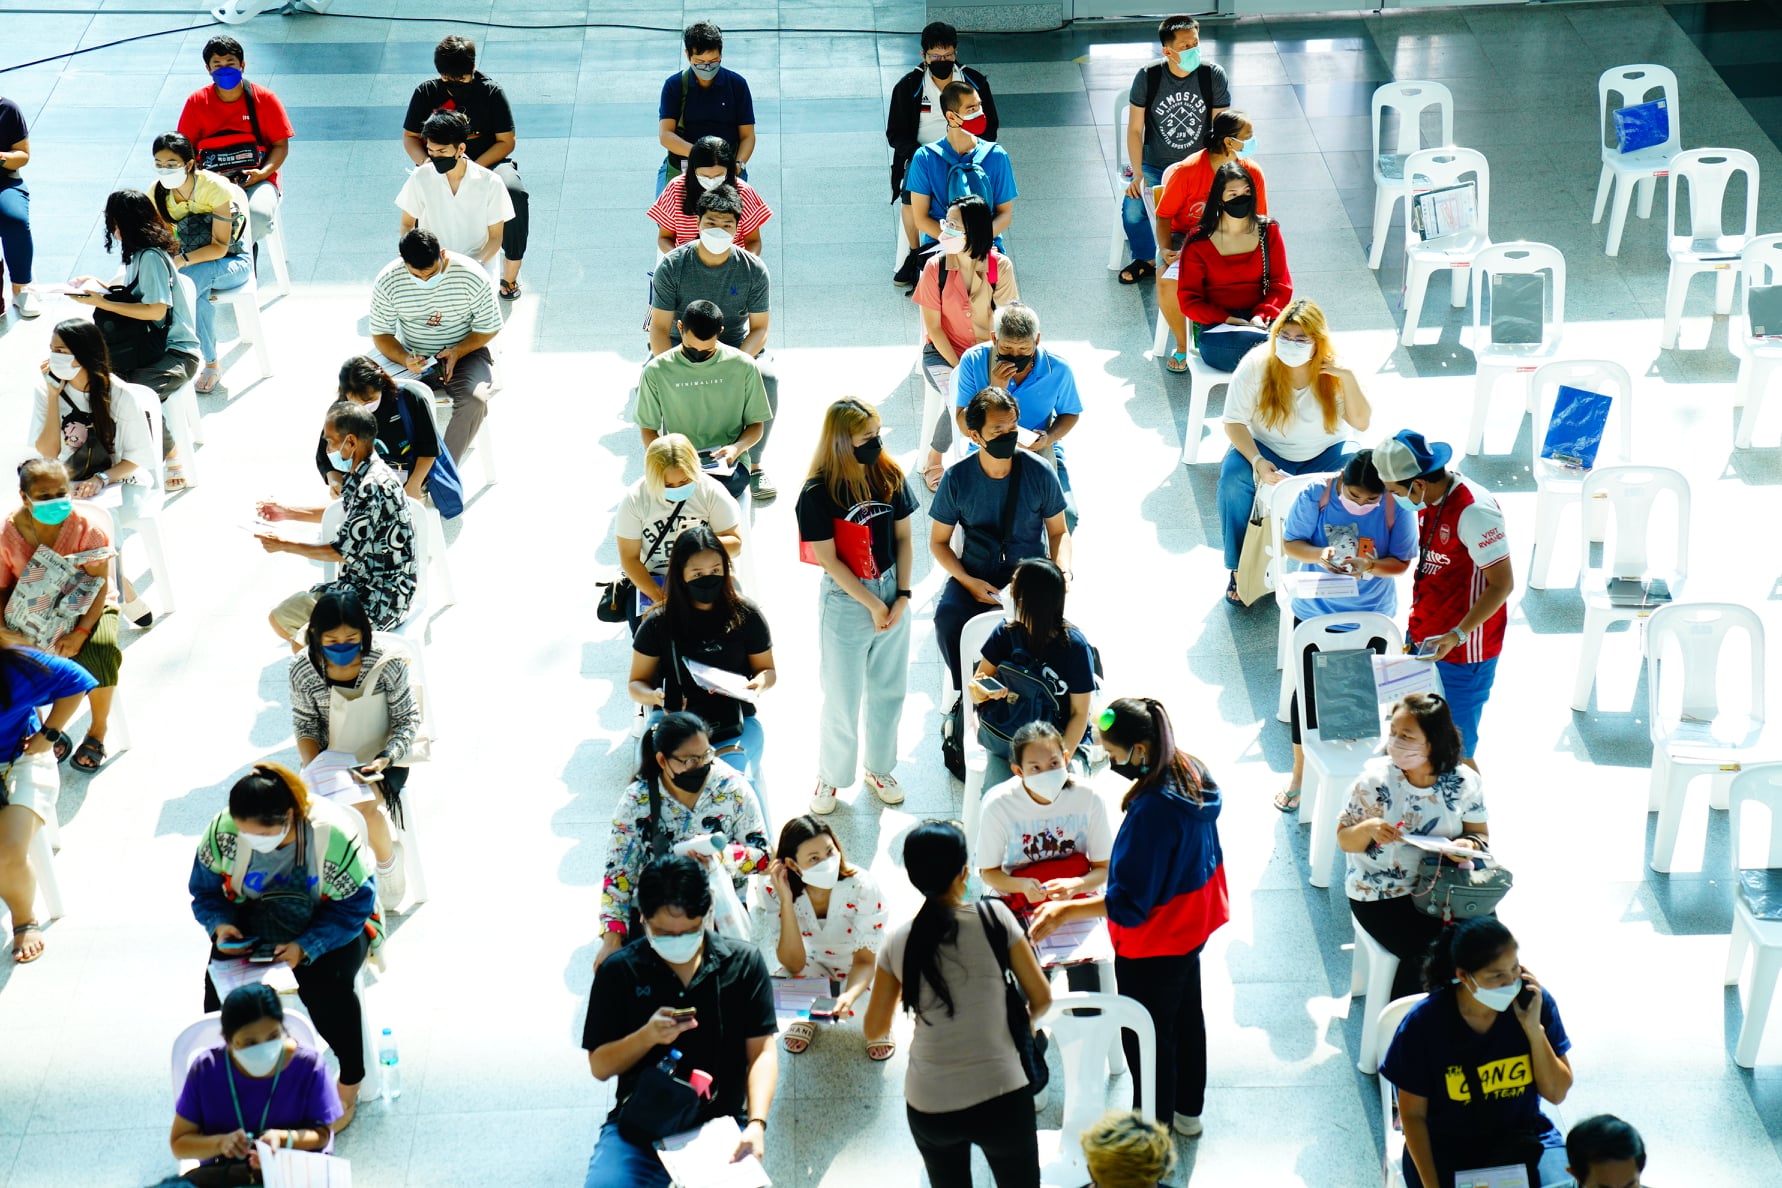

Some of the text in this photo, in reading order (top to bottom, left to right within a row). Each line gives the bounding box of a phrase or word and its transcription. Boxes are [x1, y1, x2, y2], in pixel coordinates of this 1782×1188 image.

[1167, 118, 1196, 127] 2 3
[675, 378, 723, 388] MINIMALIST
[1482, 527, 1498, 539] VISIT
